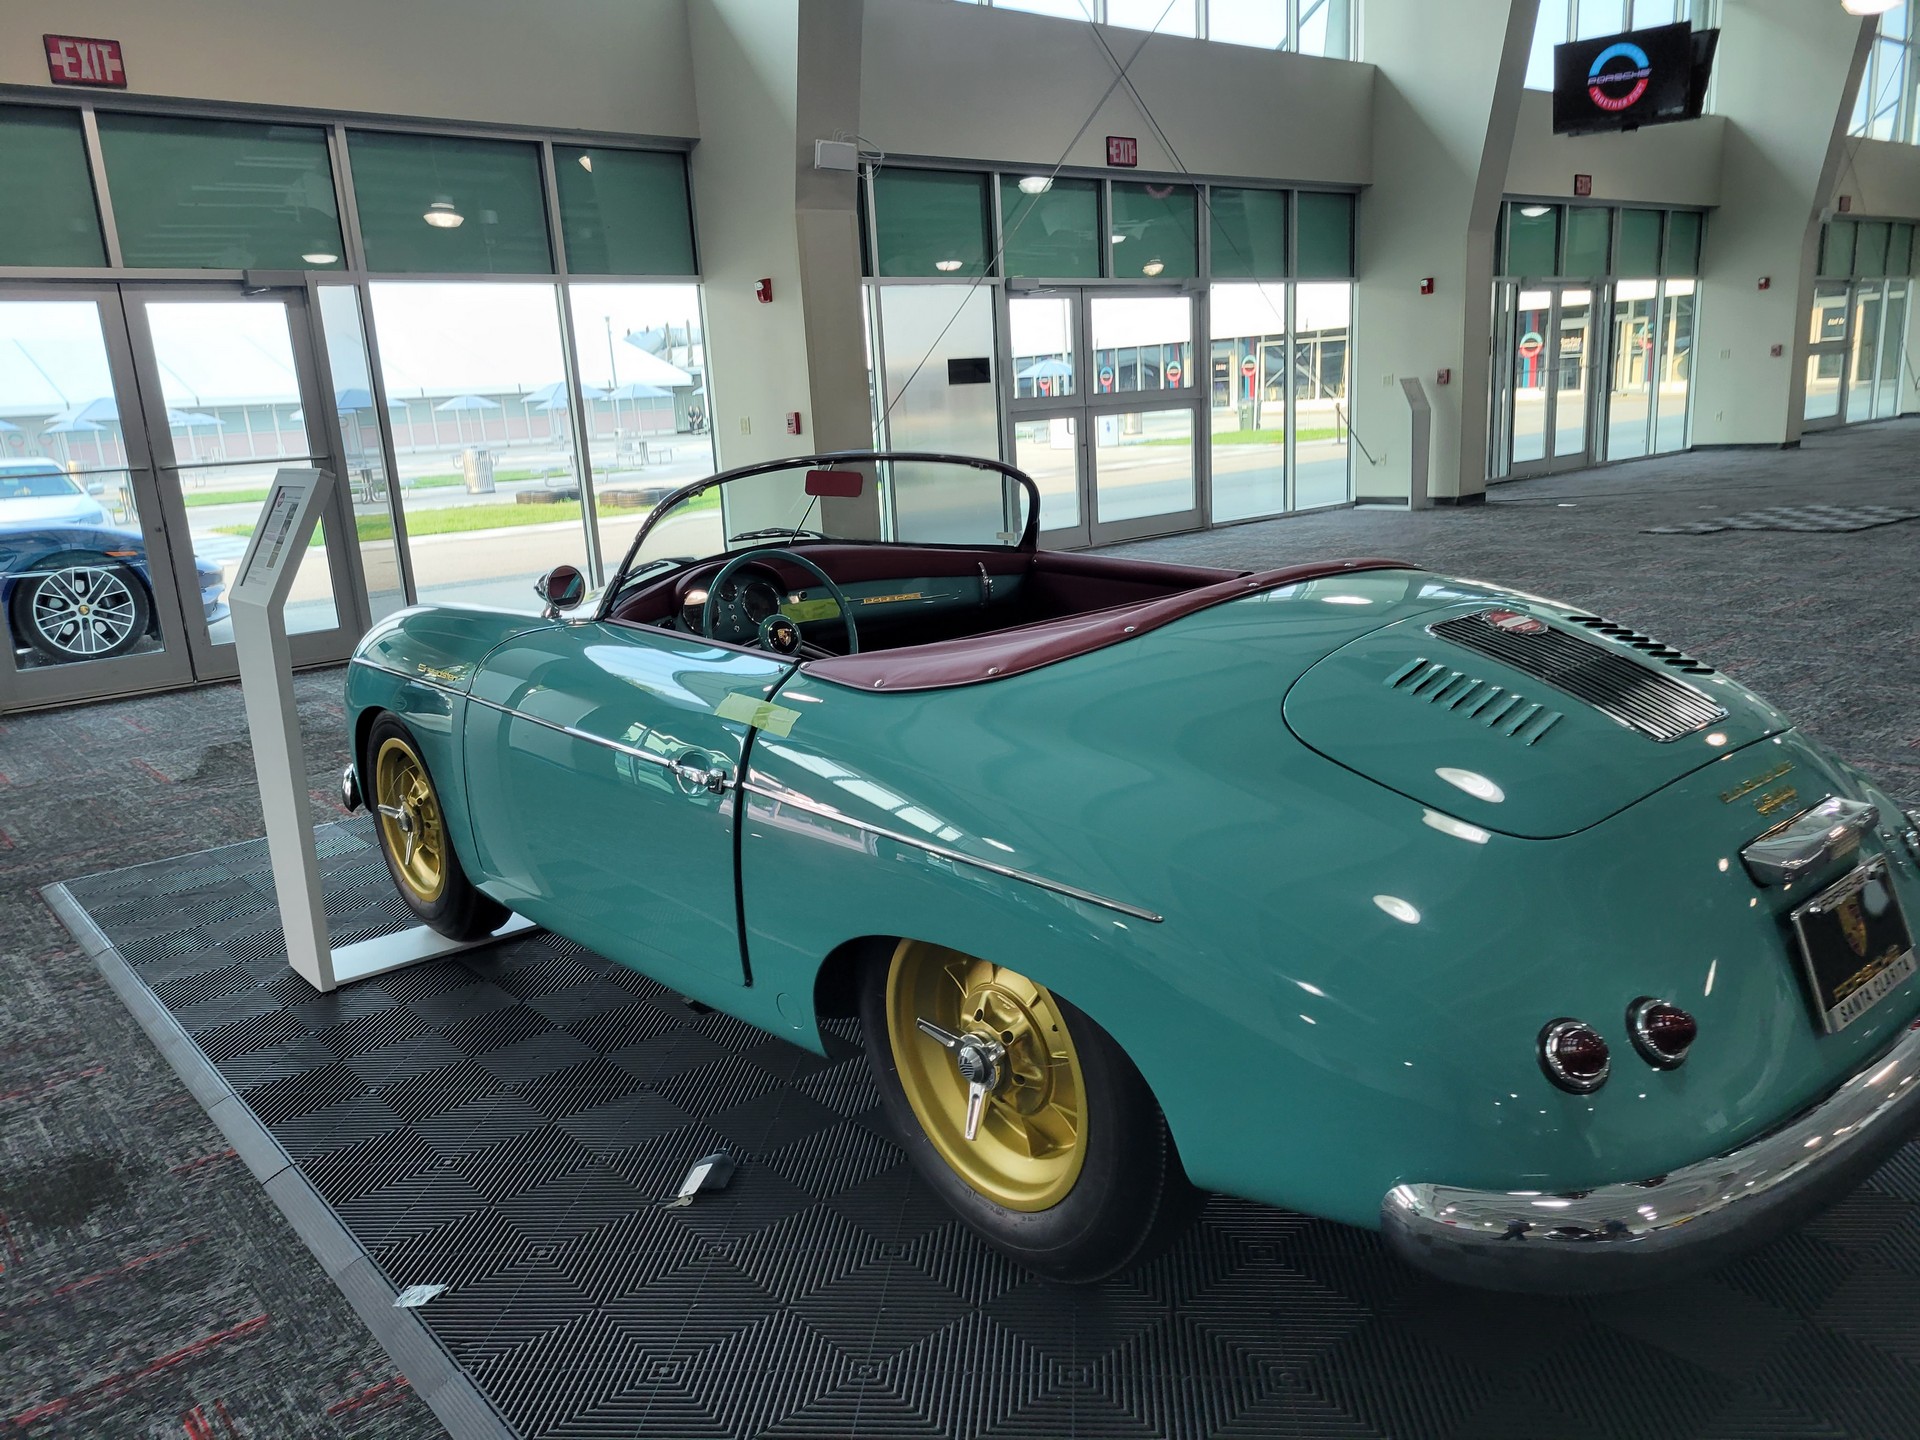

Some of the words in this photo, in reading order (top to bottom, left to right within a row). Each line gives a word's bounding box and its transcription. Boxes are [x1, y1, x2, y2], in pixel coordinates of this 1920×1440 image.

[58, 40, 114, 81] EXIT
[1587, 68, 1652, 86] PORSCHE
[1592, 87, 1628, 109] TOGETHER
[1112, 140, 1134, 163] EXIT
[1819, 872, 1866, 908] PORSCHE
[1840, 988, 1874, 1023] SANTA
[1873, 957, 1911, 997] CLARITA
